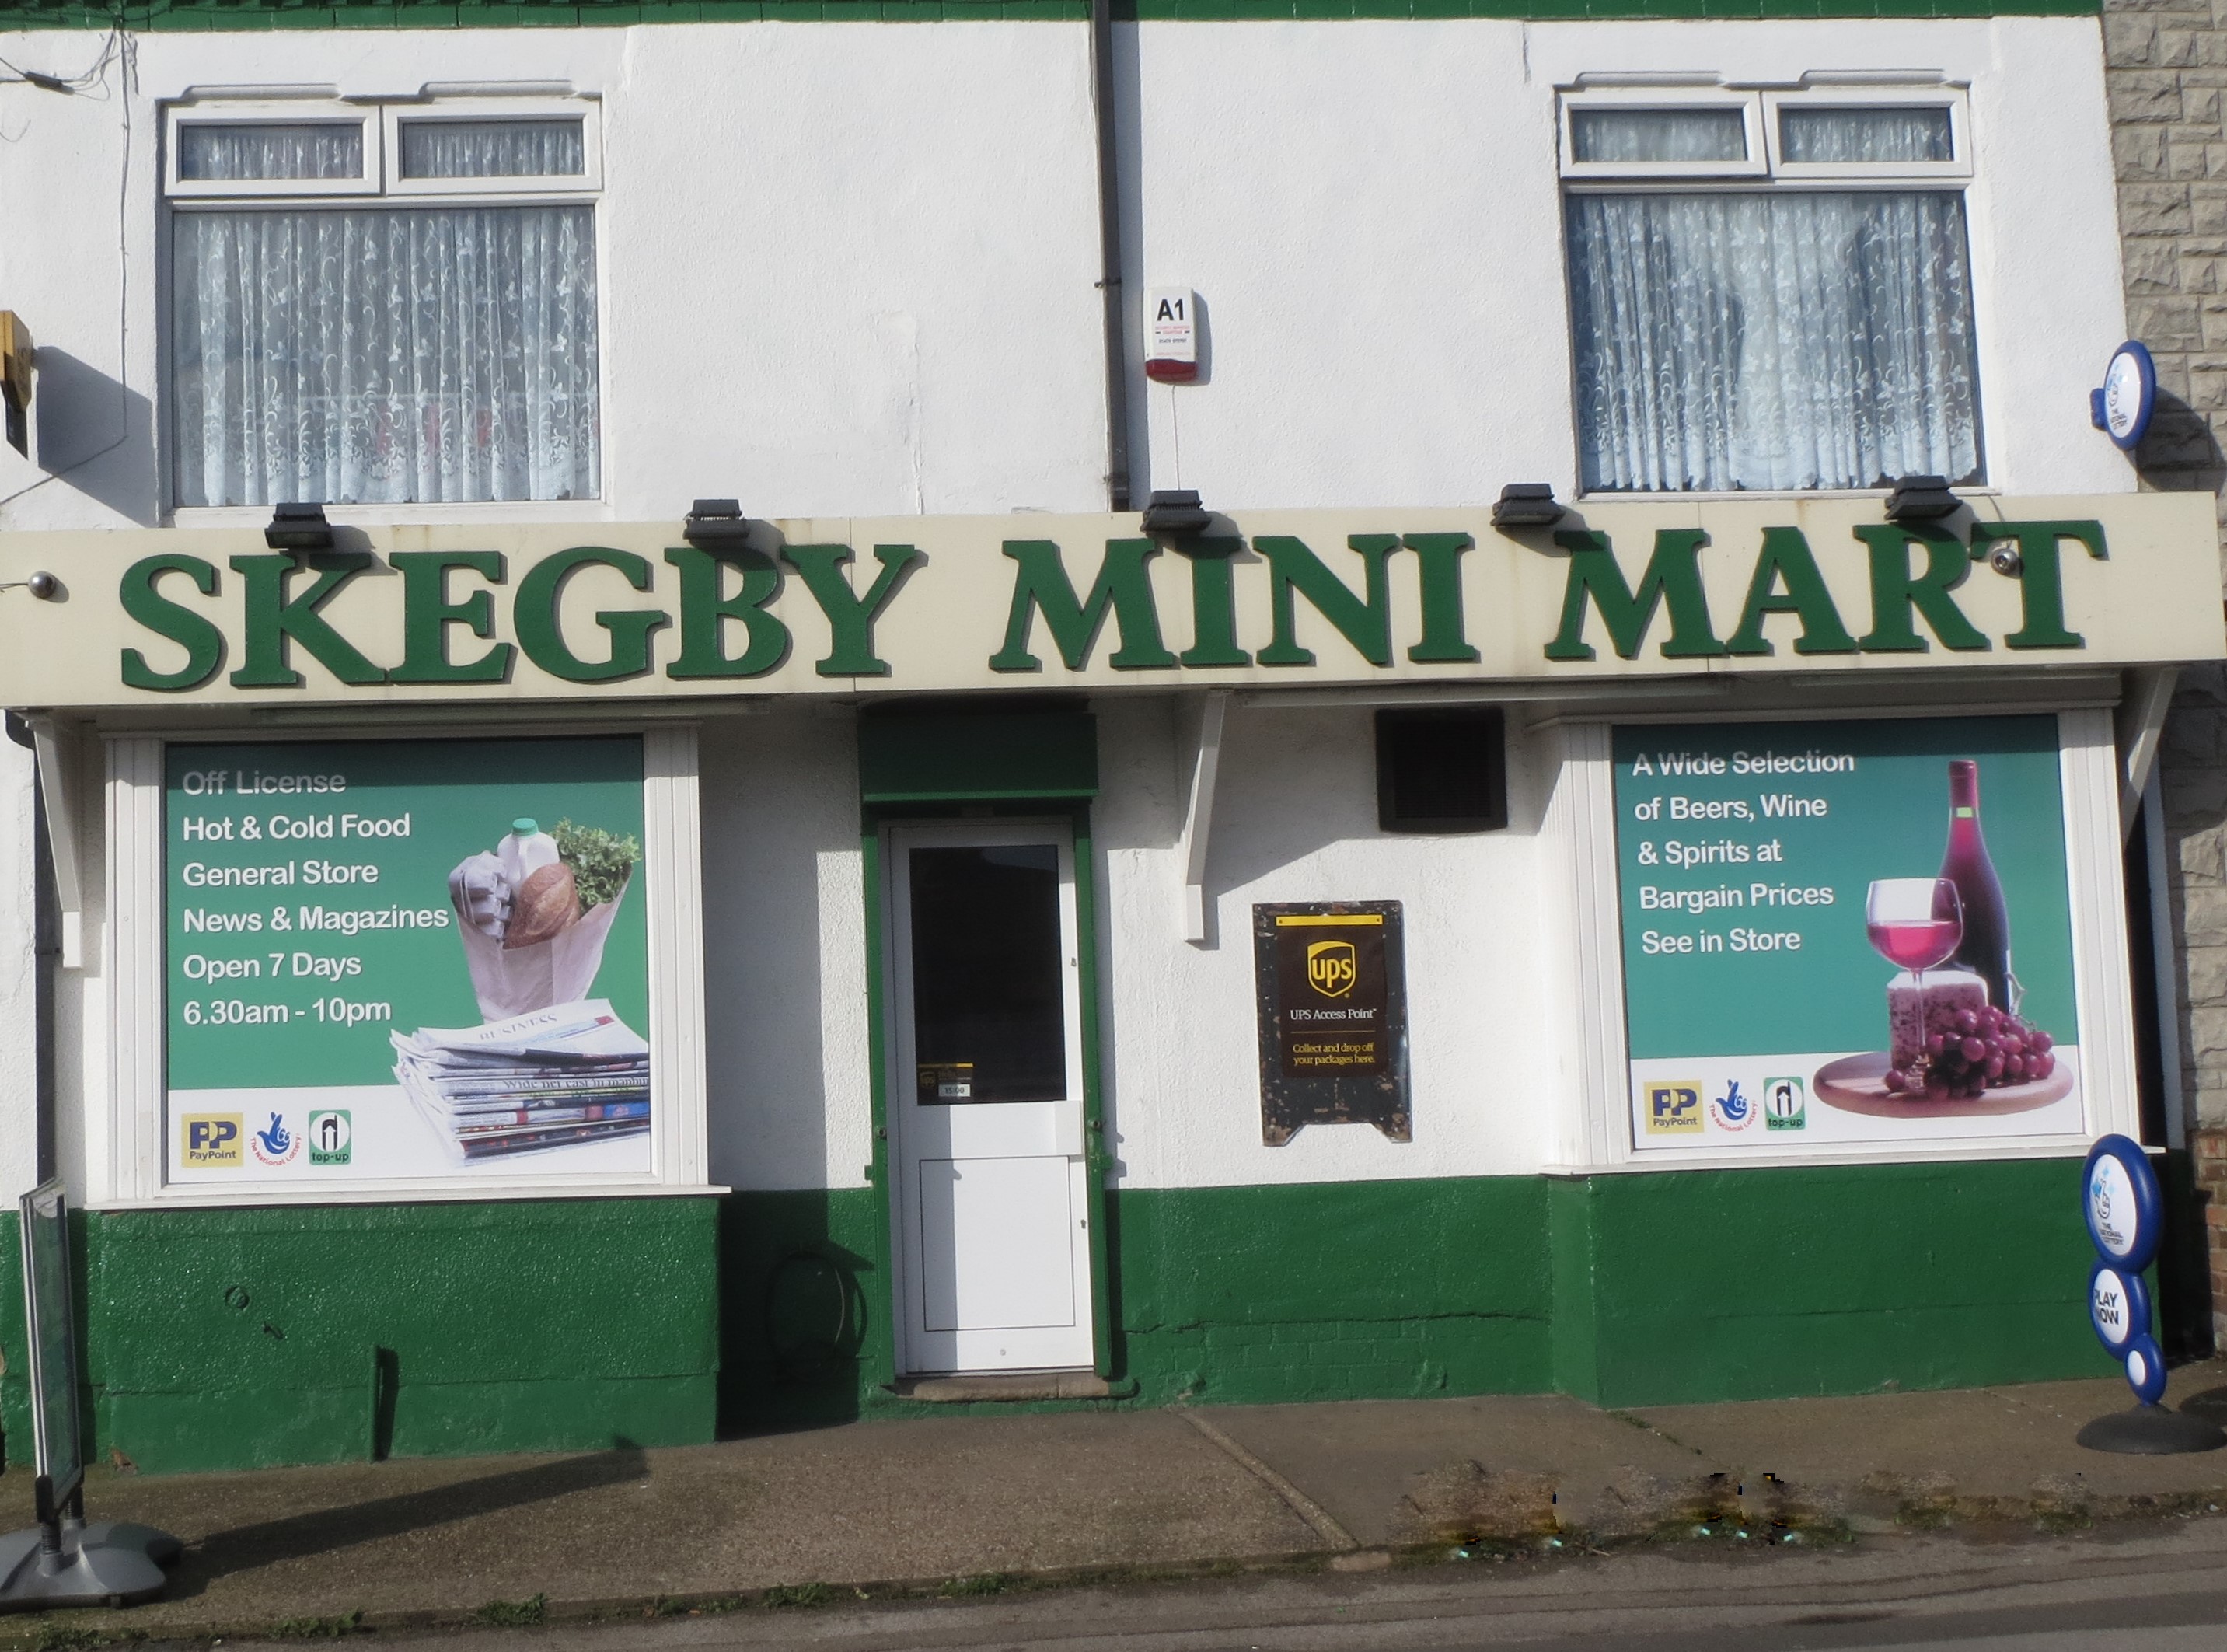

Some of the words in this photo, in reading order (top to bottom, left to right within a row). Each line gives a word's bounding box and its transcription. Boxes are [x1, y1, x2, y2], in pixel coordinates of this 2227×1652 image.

[1157, 298, 1184, 321] A1
[120, 544, 917, 690] SKEGBY
[988, 531, 1482, 671] MINI
[1545, 519, 2108, 659] MART
[1632, 753, 1653, 777] A
[1658, 752, 1726, 775] Wide
[1732, 750, 1855, 774] Selection
[183, 770, 228, 795] Off
[236, 770, 346, 795] License
[1635, 797, 1662, 820] of
[1670, 796, 1754, 822] Beers,
[1760, 795, 1827, 817] Wine
[183, 816, 233, 840] Hot
[239, 815, 262, 840] &
[268, 814, 334, 840] Cold
[340, 812, 411, 838] Food
[1638, 841, 1659, 865] &
[1664, 840, 1750, 869] Spirits
[1756, 839, 1782, 861] at
[182, 861, 295, 887] General
[302, 860, 379, 885] Store
[1640, 884, 1743, 913] Bargain
[1750, 883, 1834, 906] Prices
[183, 908, 263, 933] News
[269, 906, 291, 932] &
[299, 905, 449, 936] Magazines
[1642, 931, 1693, 954] See
[1700, 930, 1723, 952] in
[1730, 928, 1801, 952] Store
[183, 955, 260, 984] Open
[268, 954, 285, 977] 7
[292, 952, 361, 982] Days
[1311, 959, 1353, 988] ups
[183, 1000, 288, 1025] 6.30am
[312, 997, 392, 1028] 10pm
[1290, 1010, 1311, 1020] UPS
[1313, 1010, 1346, 1020] Access
[1293, 1043, 1321, 1053] Collect
[1323, 1043, 1339, 1053] and
[1341, 1043, 1361, 1053] drop
[1362, 1043, 1374, 1052] off
[1293, 1057, 1313, 1066] your
[1315, 1055, 1353, 1066] packages
[1354, 1054, 1375, 1063] here.
[1653, 1117, 1697, 1127] PayPoint
[1768, 1119, 1803, 1127] top-up
[190, 1150, 236, 1161] PayPoint
[255, 1151, 285, 1166] National
[285, 1136, 302, 1161] Lottery
[312, 1152, 349, 1162] top-up
